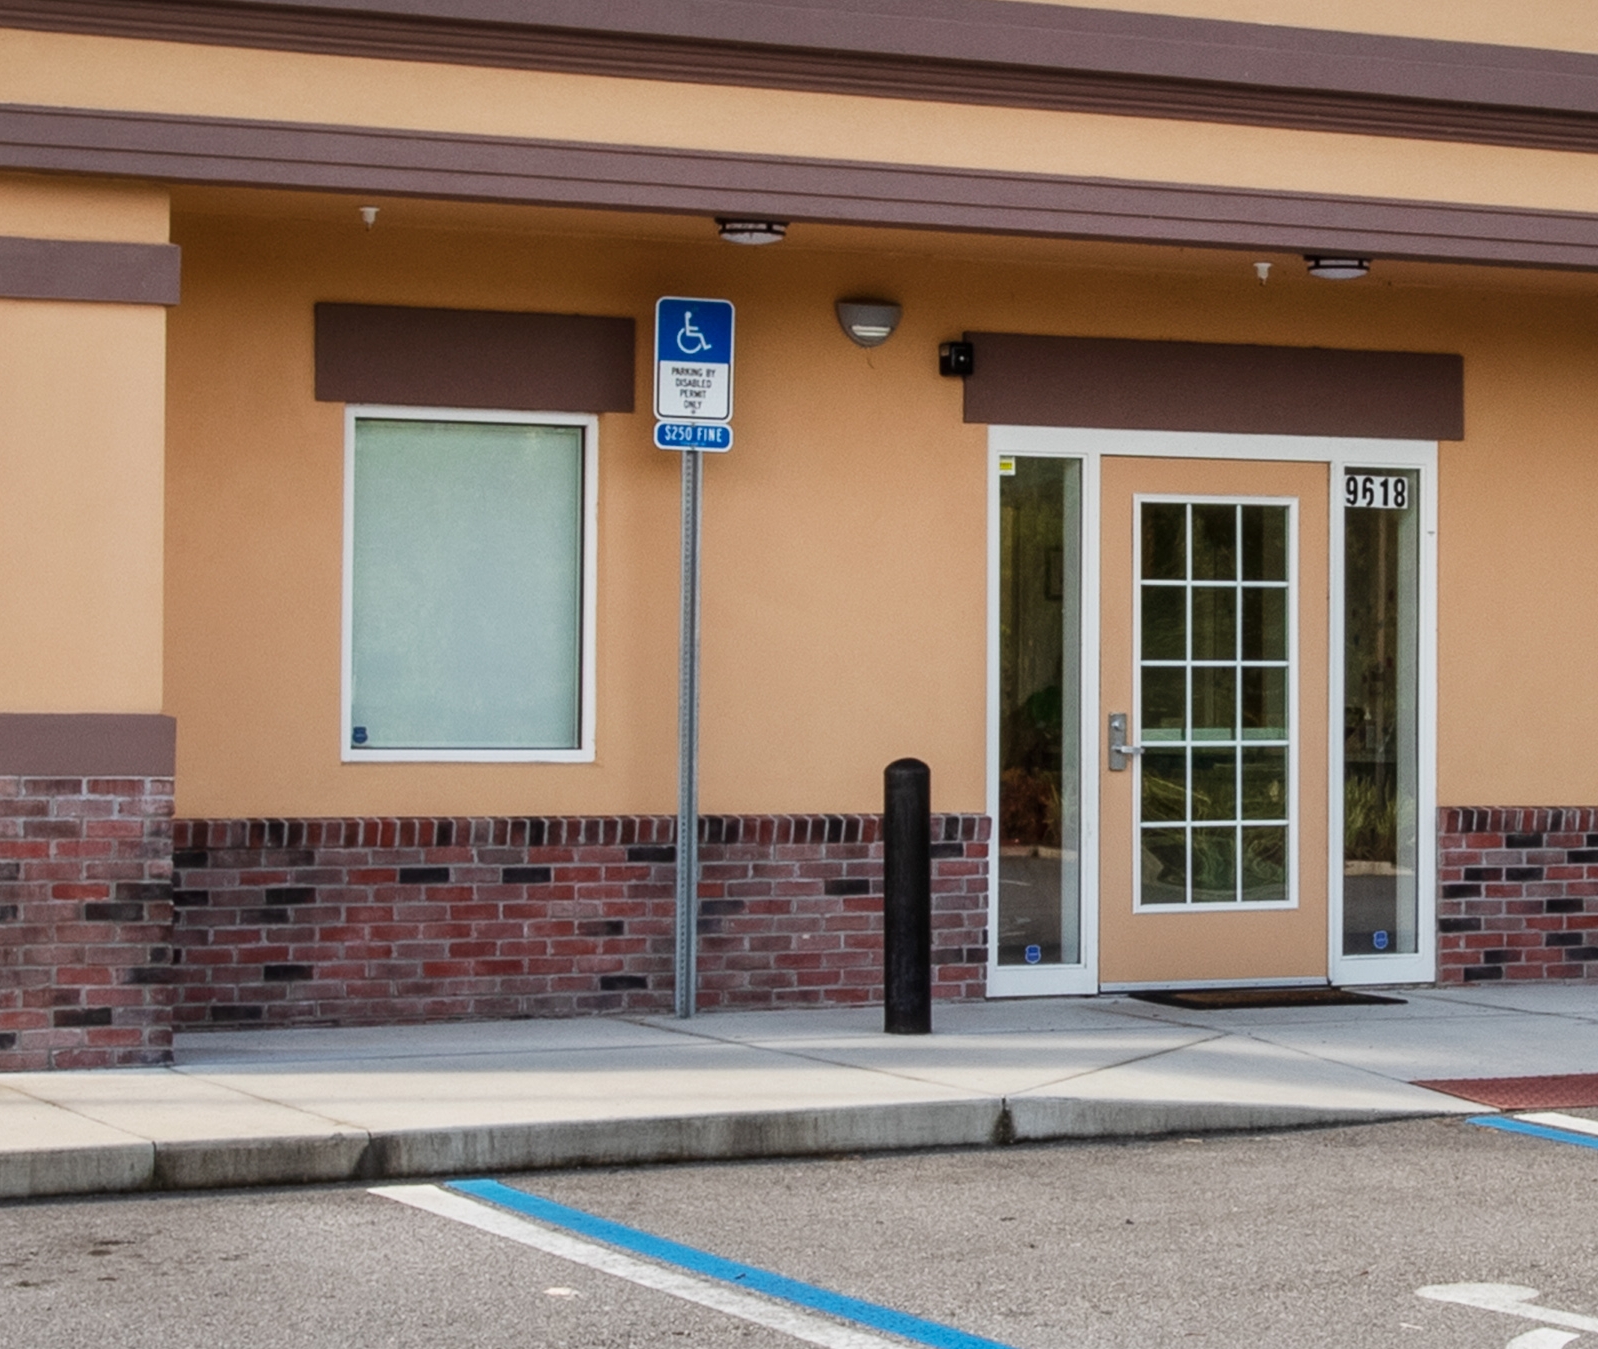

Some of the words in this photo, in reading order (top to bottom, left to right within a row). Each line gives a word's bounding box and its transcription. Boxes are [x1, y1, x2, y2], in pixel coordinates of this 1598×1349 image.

[671, 367, 703, 377] PARKING
[705, 369, 716, 378] BY
[675, 378, 712, 389] DISABLED
[679, 389, 706, 399] PERMIT
[683, 400, 702, 410] ONLY
[664, 425, 693, 441] $250
[697, 427, 723, 443] FINE
[1345, 475, 1406, 508] 9618
